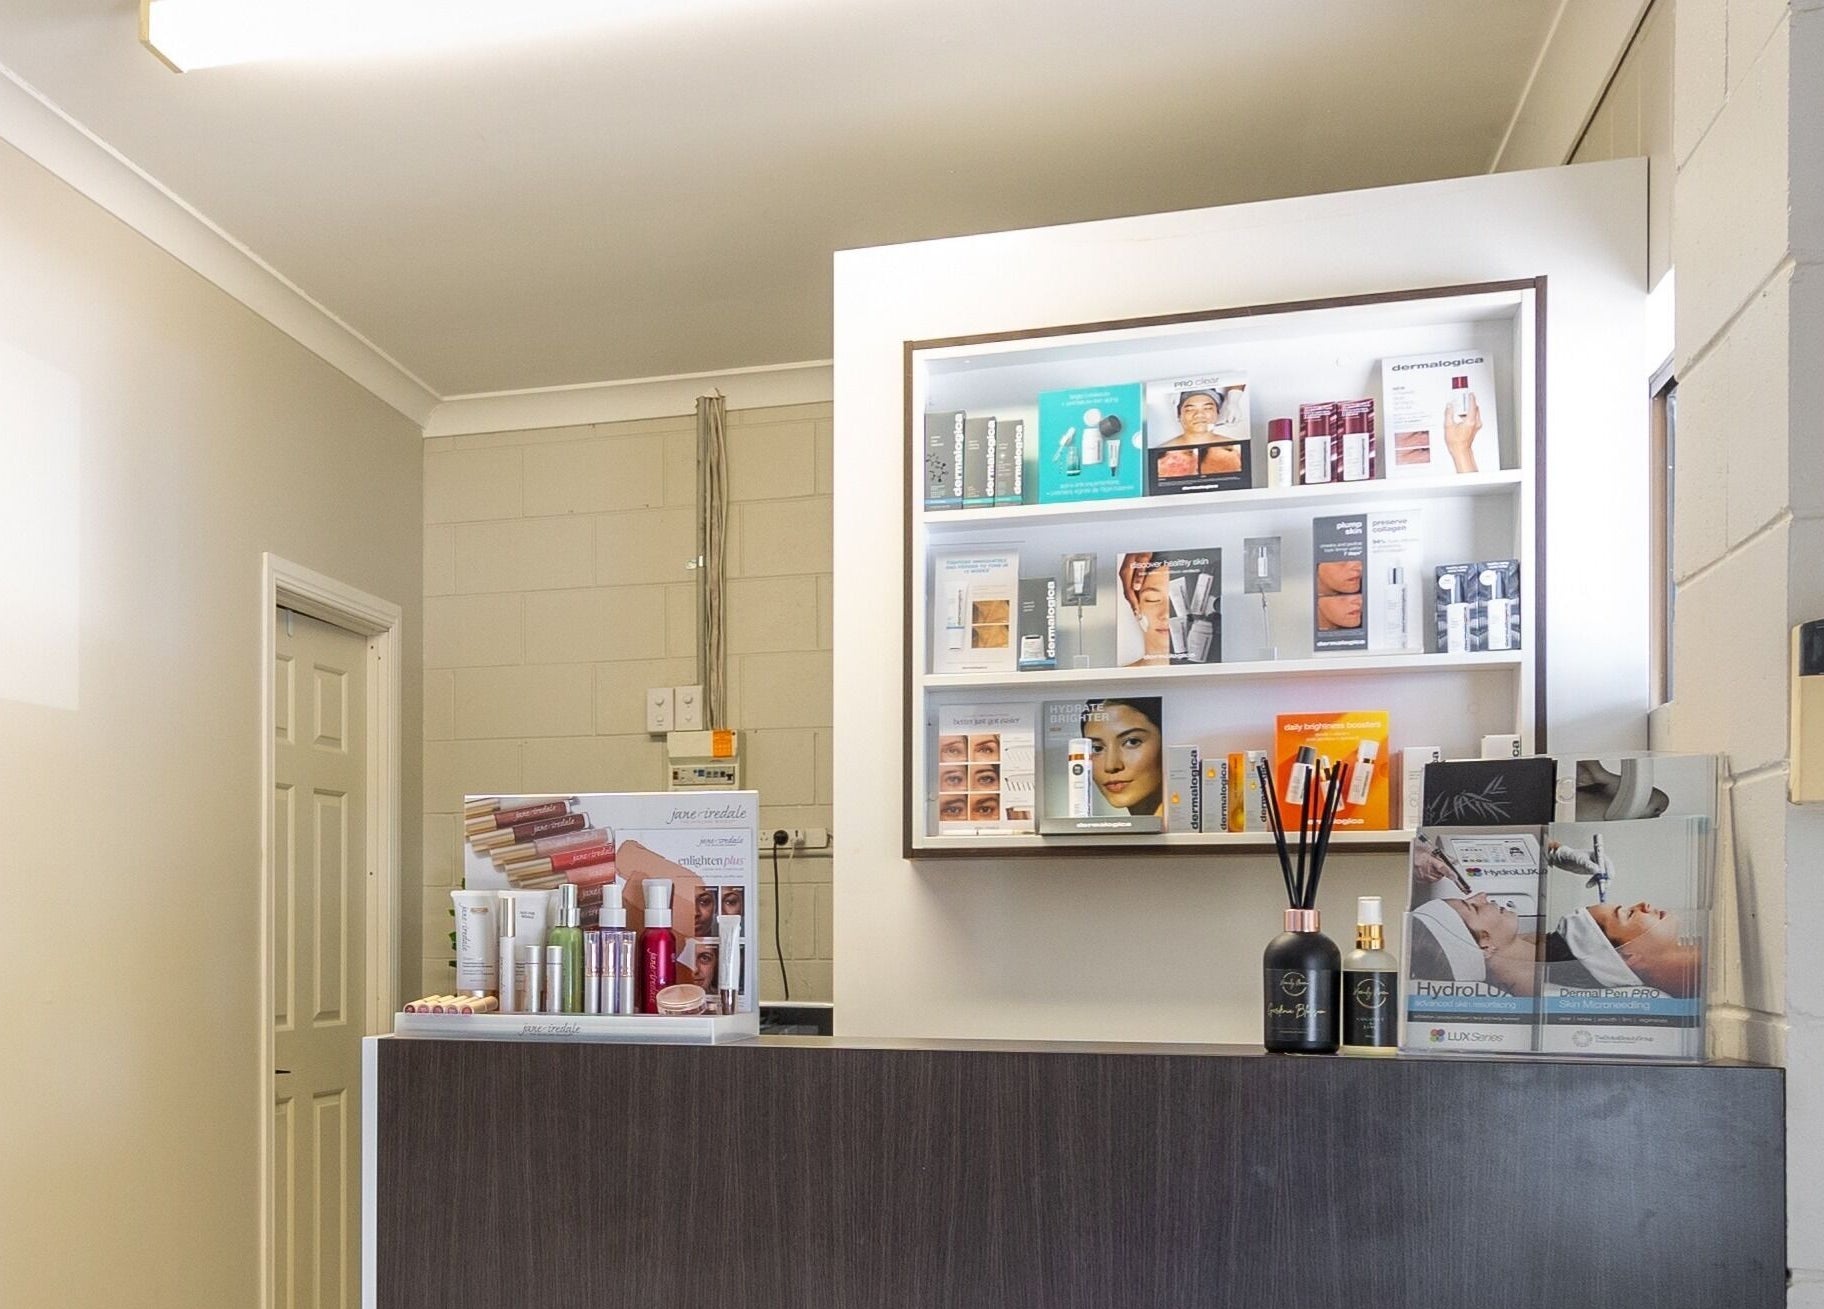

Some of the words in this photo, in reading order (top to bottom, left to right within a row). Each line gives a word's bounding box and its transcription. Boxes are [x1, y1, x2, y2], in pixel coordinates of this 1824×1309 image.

[1392, 357, 1484, 372] dermalogica
[953, 413, 964, 497] dermalogica
[986, 420, 996, 496] dermalogica
[1014, 424, 1023, 495] dermalogica
[1046, 581, 1056, 658] dermalogica
[1049, 704, 1105, 714] HYDRATE
[1050, 713, 1110, 723] BRIGHTER
[1190, 750, 1200, 831] dermalogica
[667, 808, 697, 824] jane
[699, 805, 746, 819] iredale
[678, 855, 723, 868] enlighten
[723, 856, 745, 868] plus
[1418, 981, 1516, 999] HydroLUX
[1559, 987, 1601, 998] Dermal
[1605, 988, 1628, 998] Pen
[1631, 988, 1660, 999] PRO
